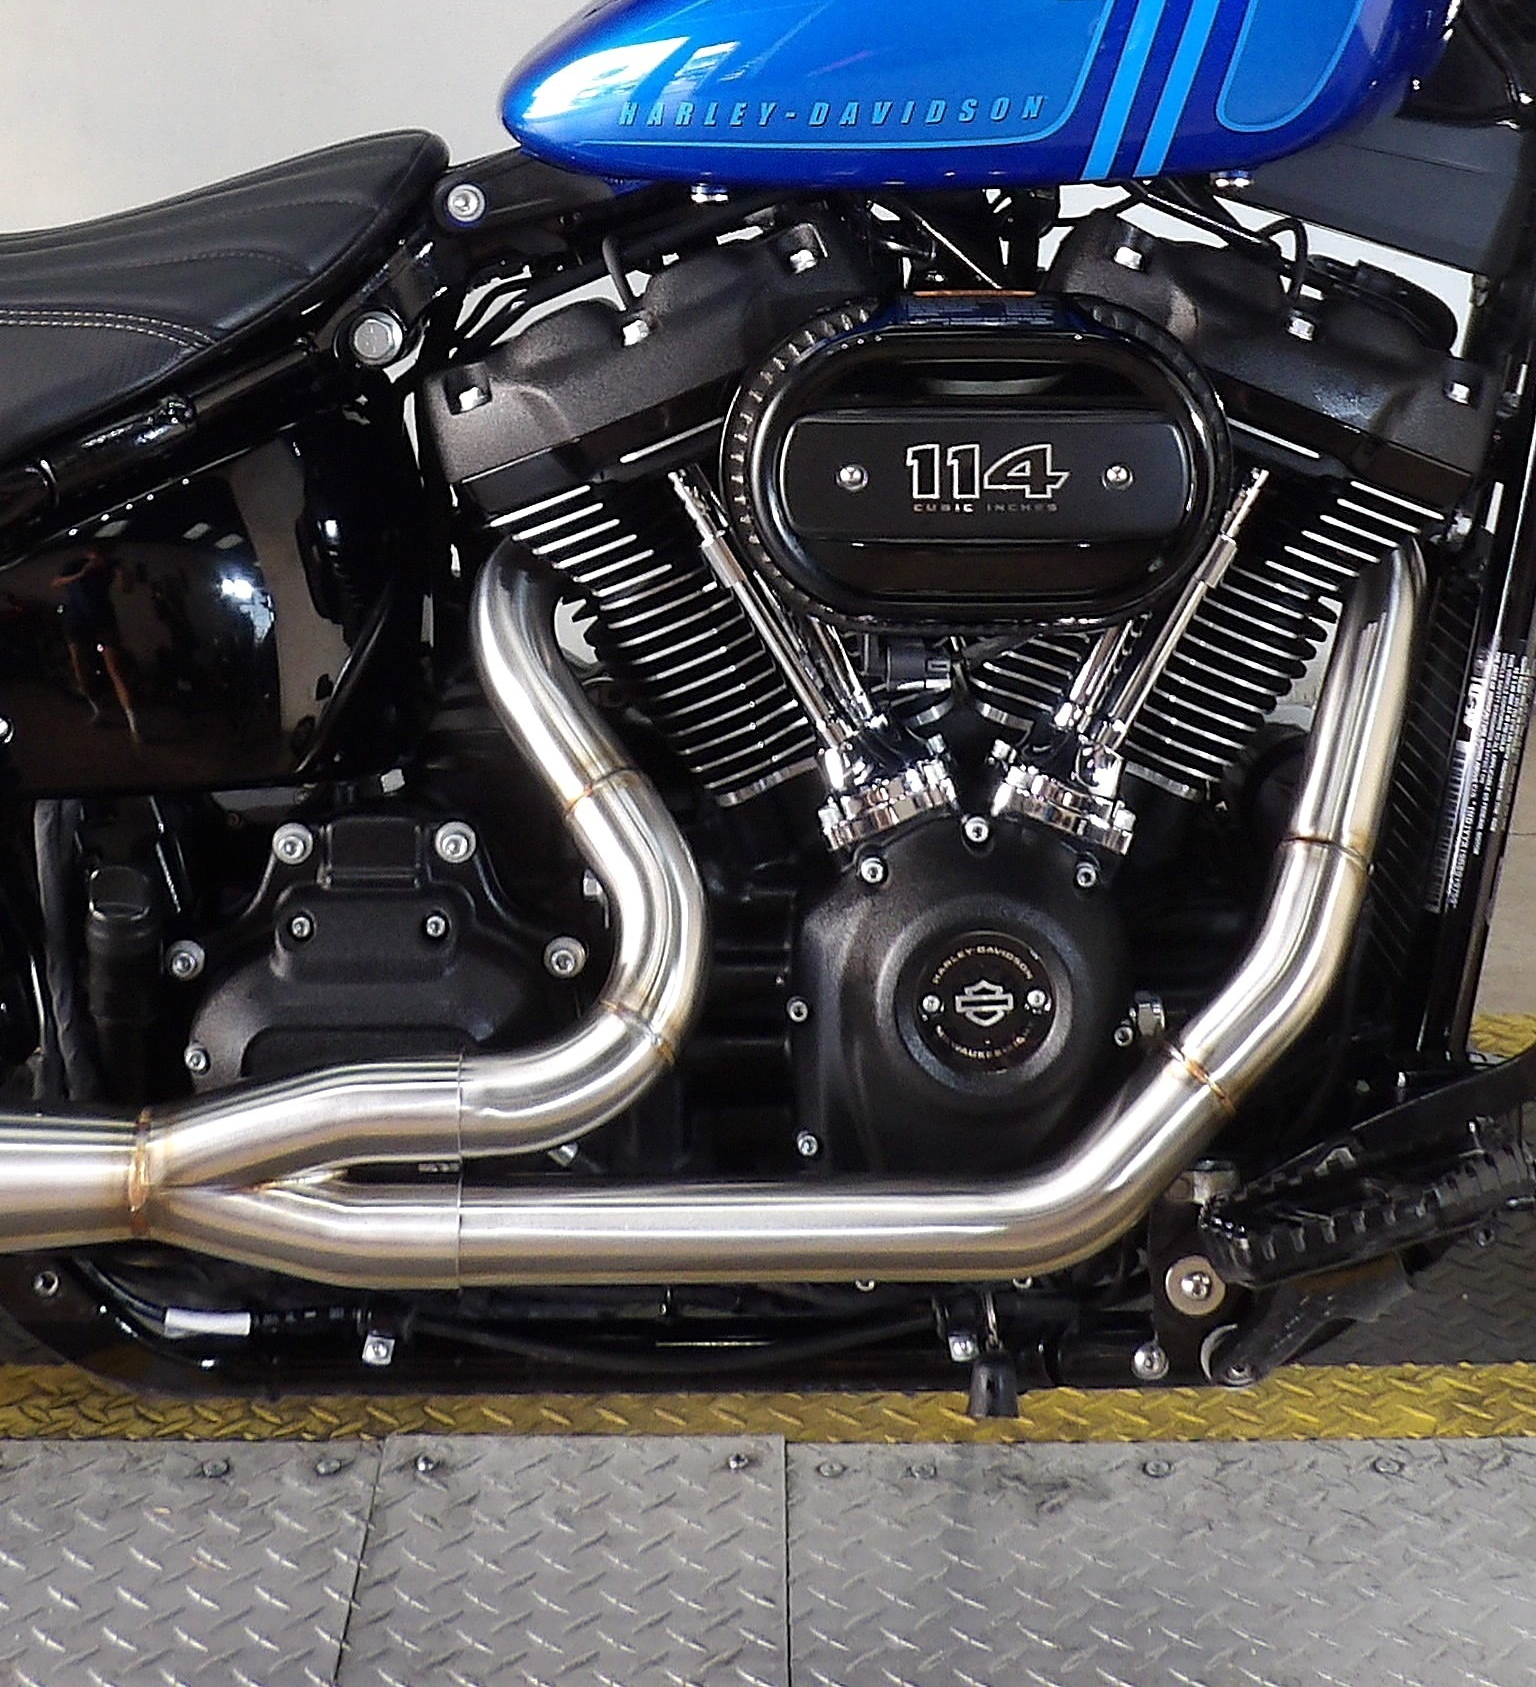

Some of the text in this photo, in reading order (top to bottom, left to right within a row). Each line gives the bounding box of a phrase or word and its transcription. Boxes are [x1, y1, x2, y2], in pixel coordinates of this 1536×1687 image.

[617, 94, 1048, 128] HARLEY-DAVIDSON
[905, 442, 1072, 500] 114
[912, 501, 1059, 514] CUBIC INCHES
[931, 945, 1035, 985] HARLEY-DAVIDSON
